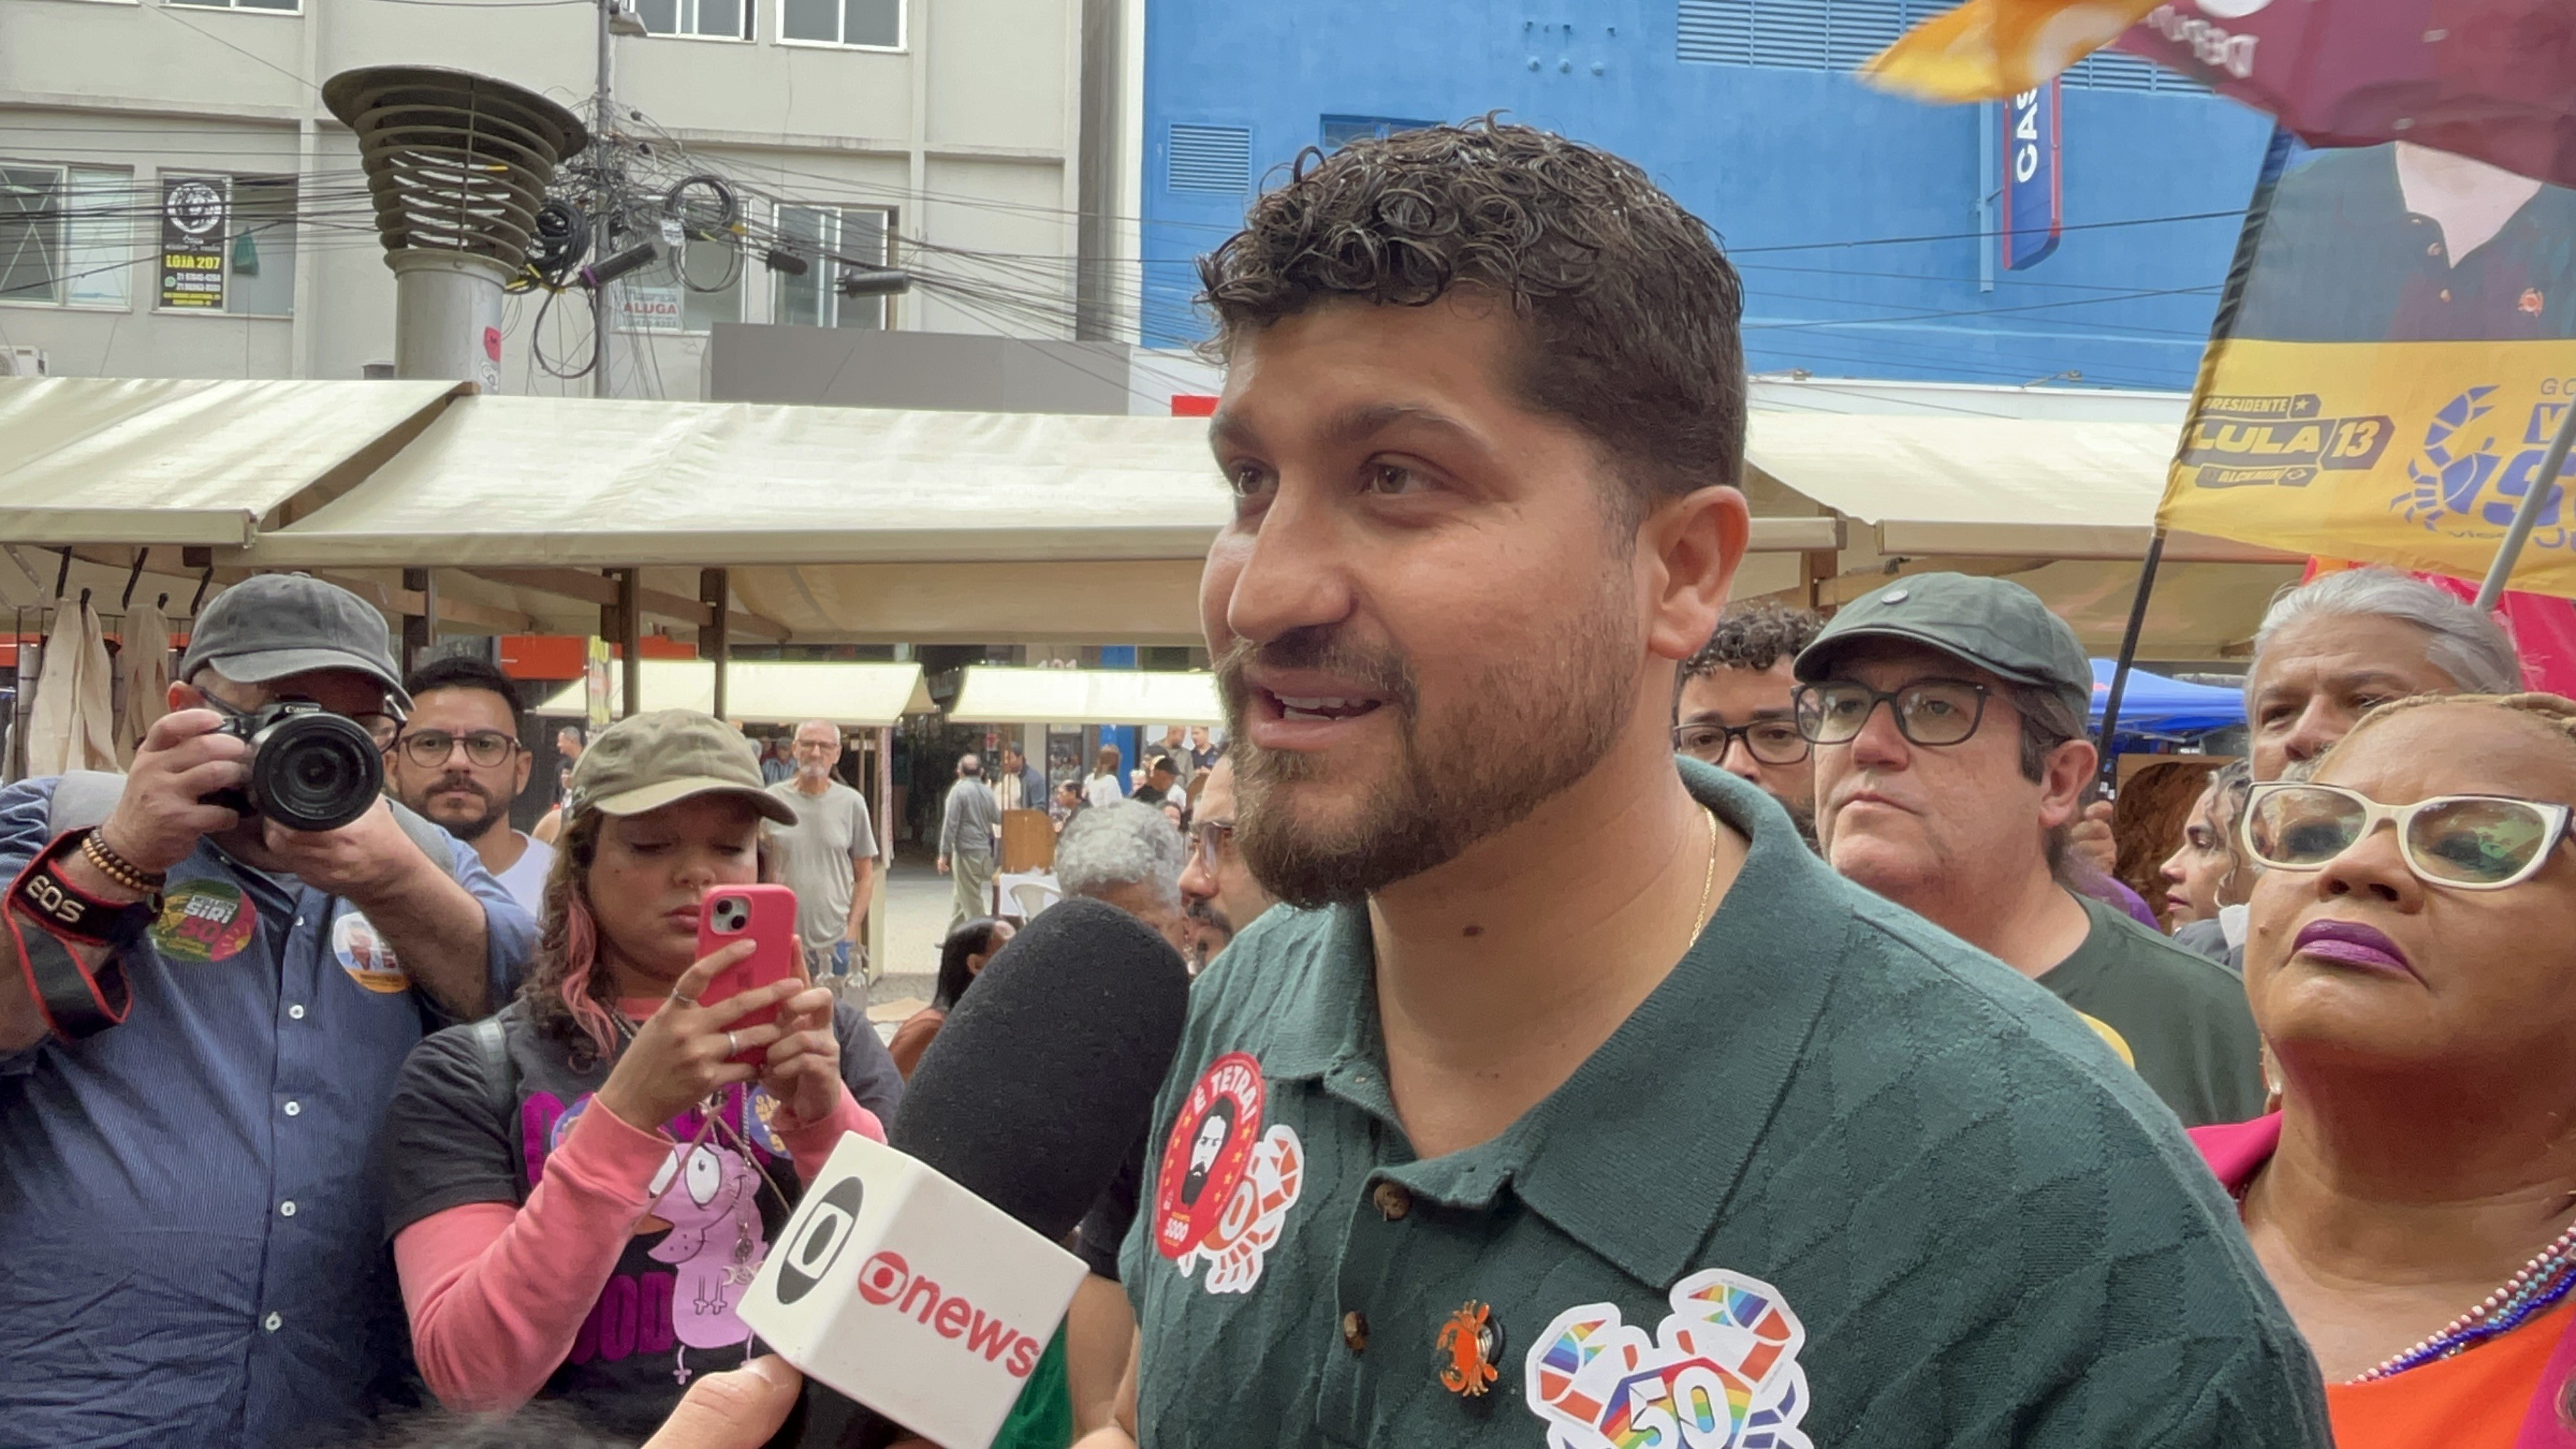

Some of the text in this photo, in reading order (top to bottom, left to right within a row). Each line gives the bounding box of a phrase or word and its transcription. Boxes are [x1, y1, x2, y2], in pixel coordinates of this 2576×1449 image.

[165, 255, 221, 269] LOJA 207
[624, 302, 677, 315] ALUGA
[2188, 420, 2381, 458] LULA 13
[25, 875, 86, 924] EOS
[898, 1274, 1041, 1379] news
[1628, 1364, 1731, 1449] 50
